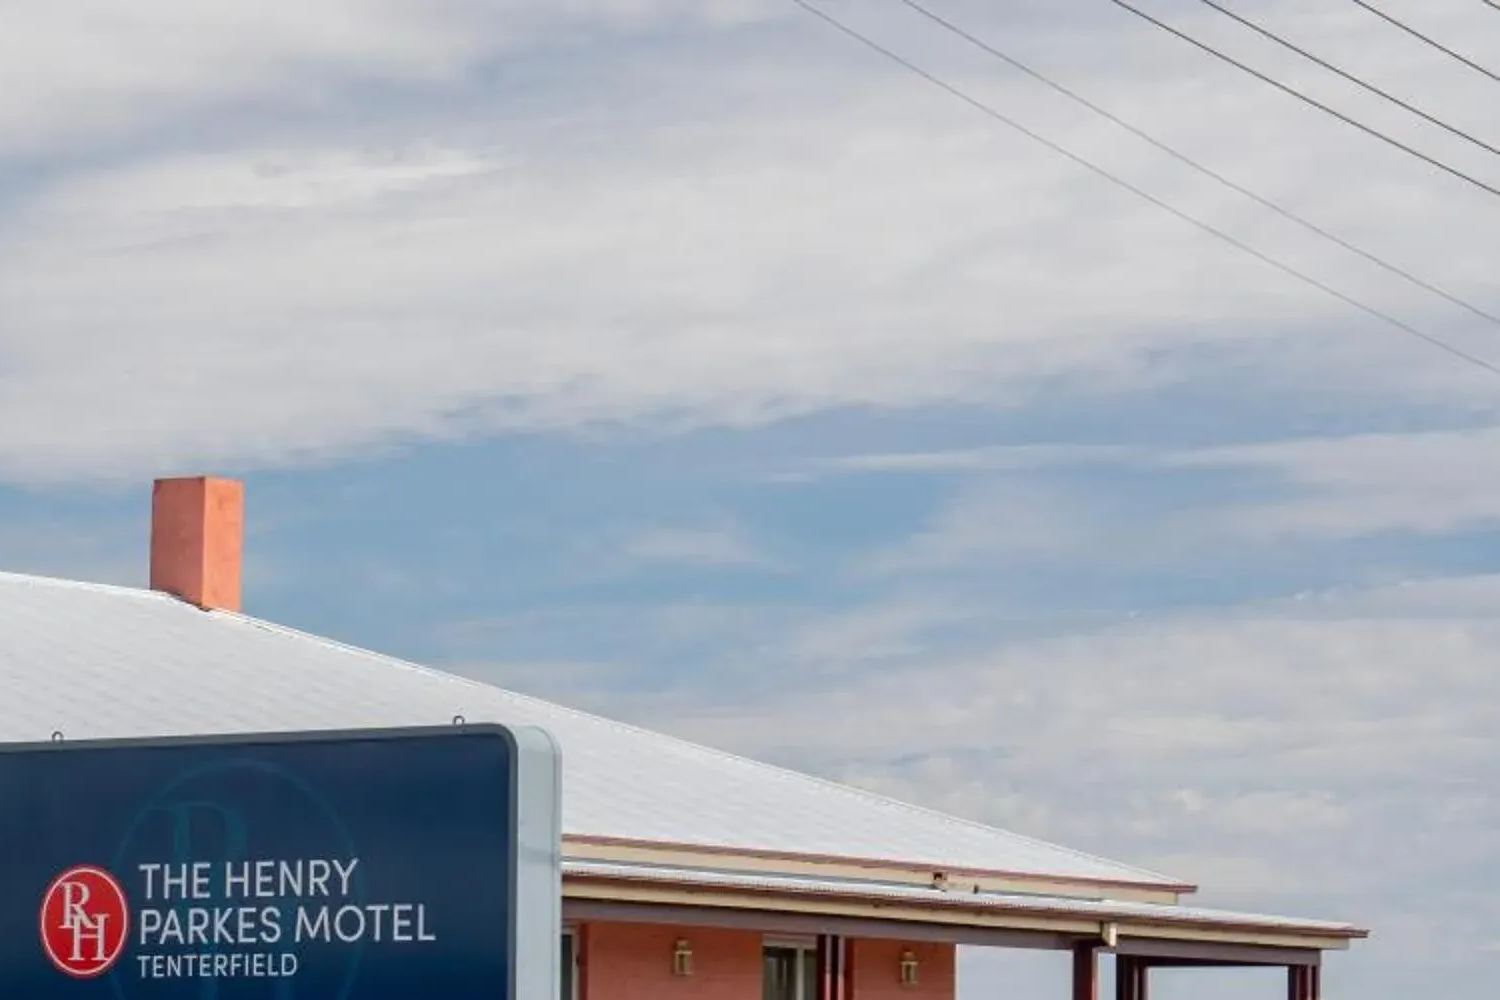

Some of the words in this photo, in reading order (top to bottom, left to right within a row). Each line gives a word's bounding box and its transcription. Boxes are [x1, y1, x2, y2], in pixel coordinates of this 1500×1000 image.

[139, 862, 211, 900] THE
[225, 858, 359, 898] HENRY
[140, 906, 281, 945] PARKES
[295, 904, 436, 942] MOTEL
[137, 953, 298, 978] TENTERFIELD
